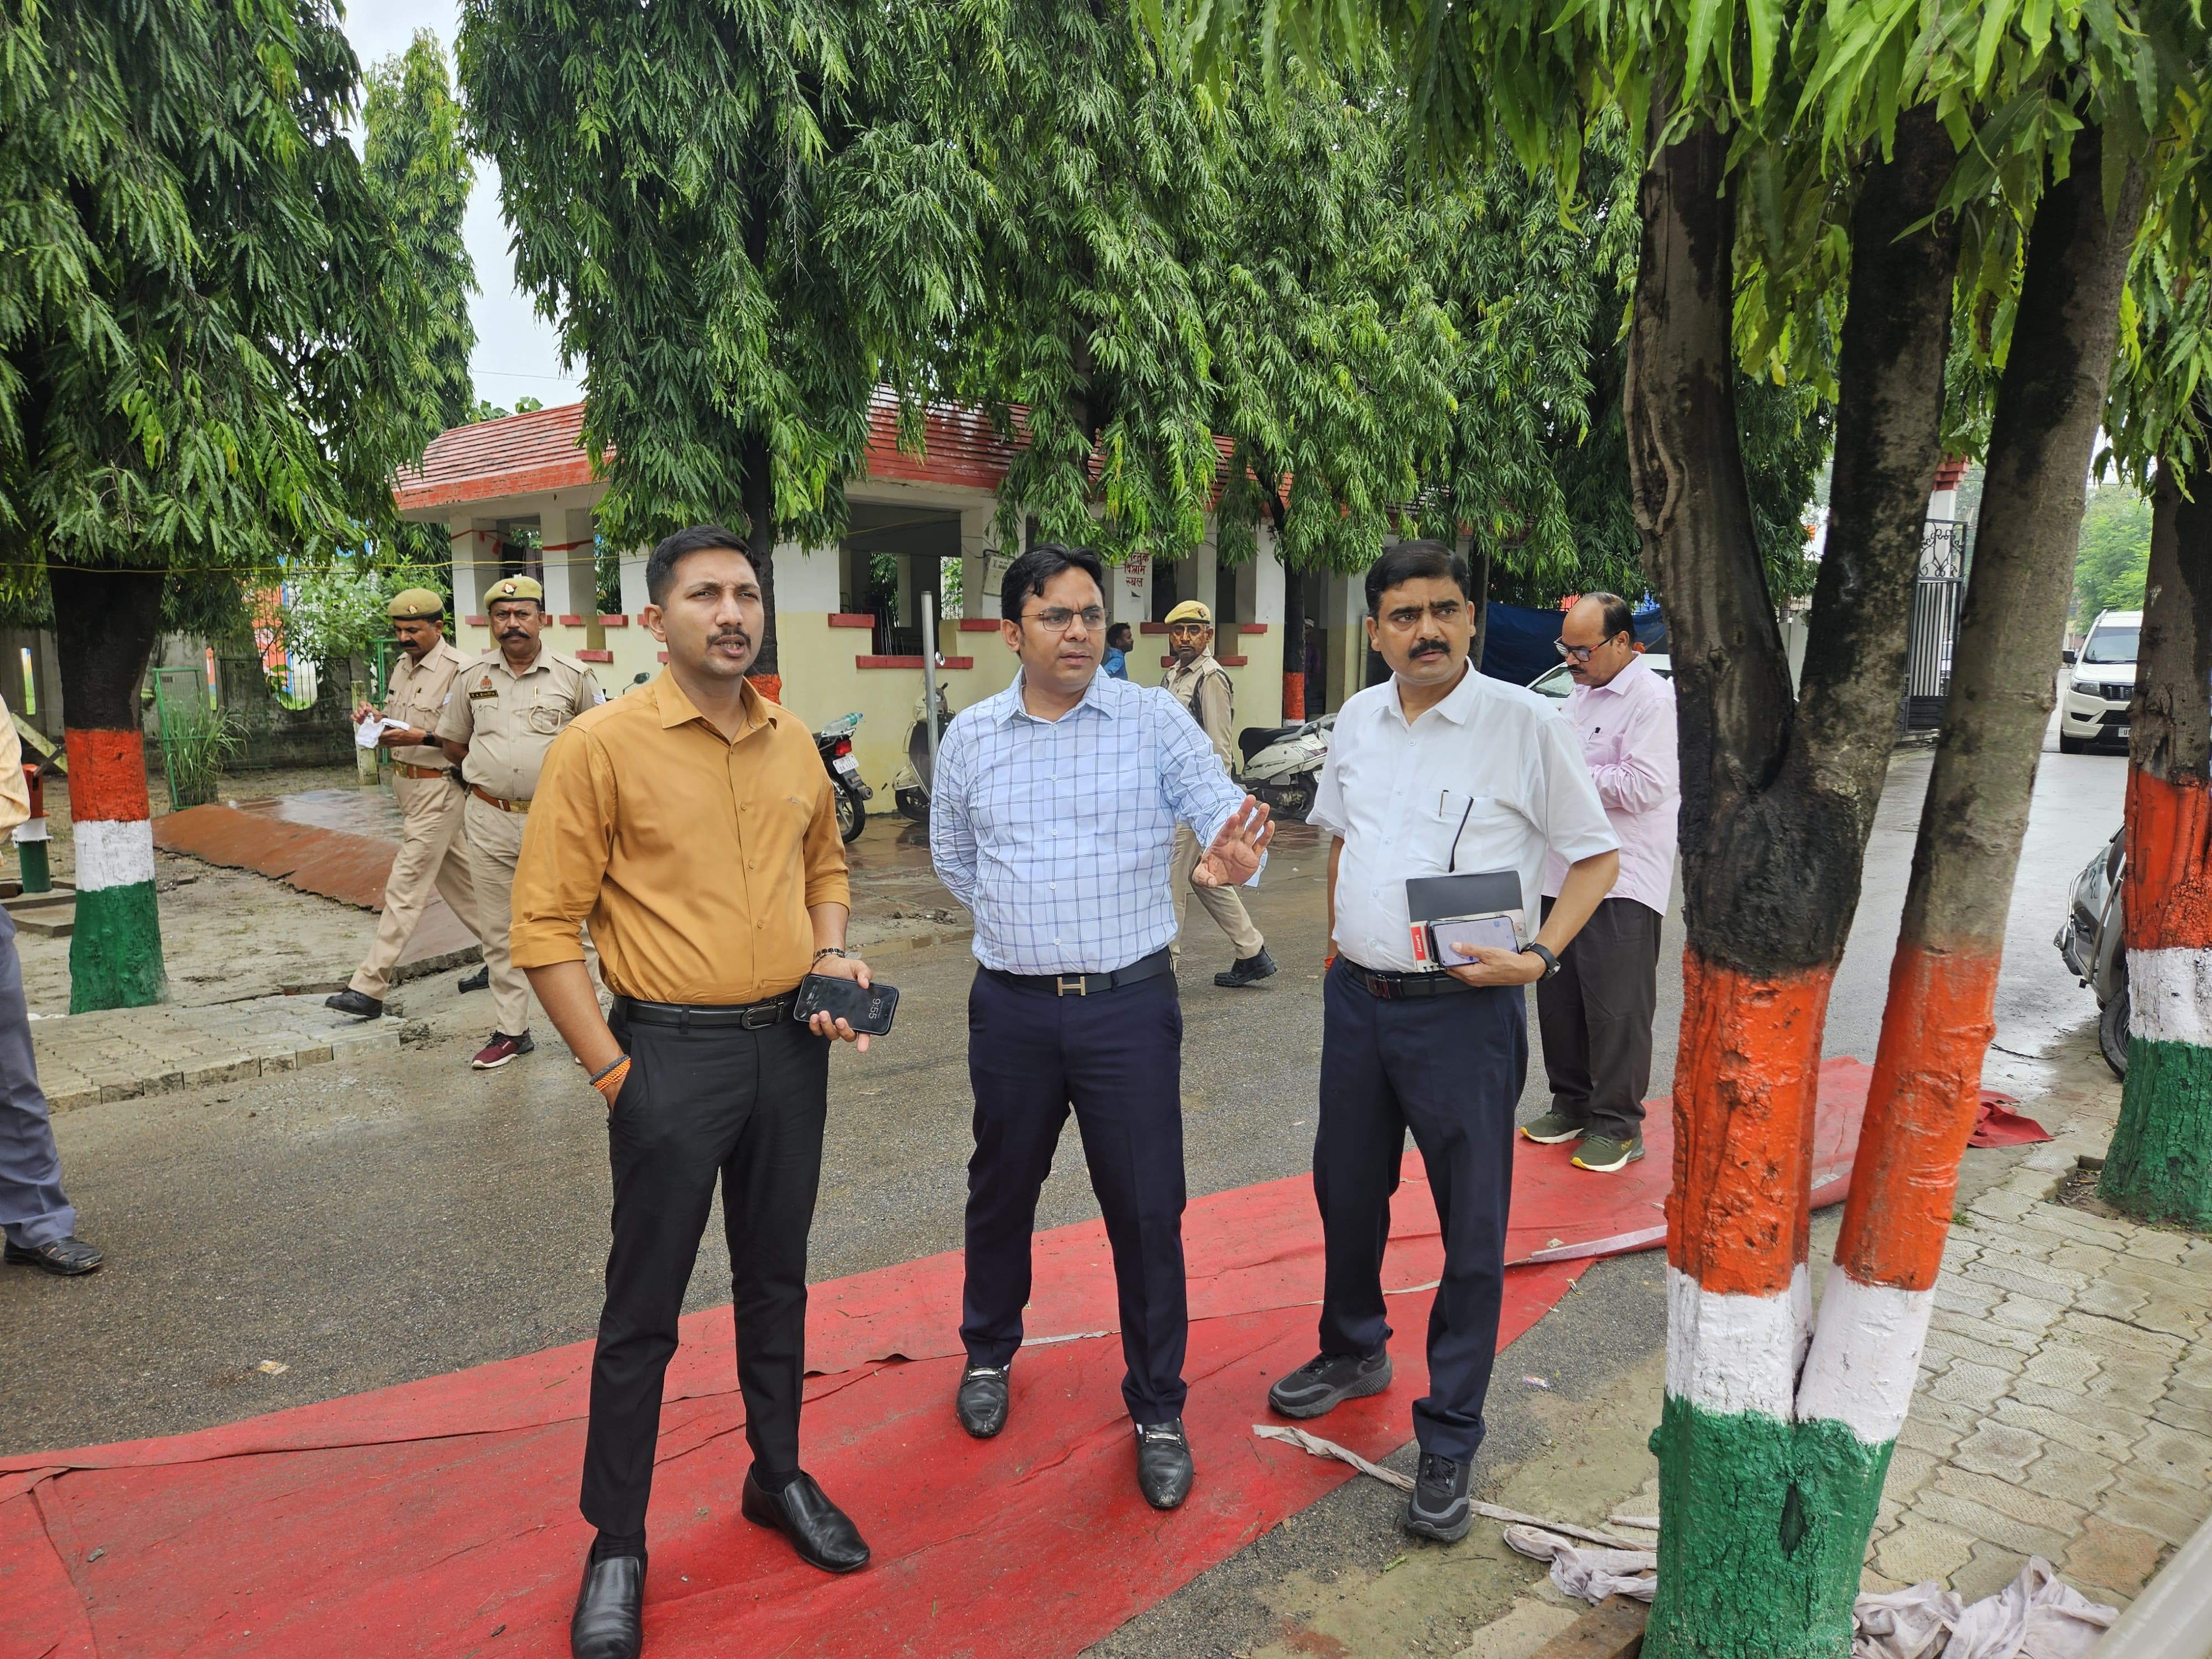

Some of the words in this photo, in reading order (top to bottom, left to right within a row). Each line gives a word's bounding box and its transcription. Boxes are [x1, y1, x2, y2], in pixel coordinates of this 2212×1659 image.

[1123, 562, 1146, 575] विश्राम
[1125, 576, 1144, 587] स्थल
[868, 998, 880, 1019] 9:55
